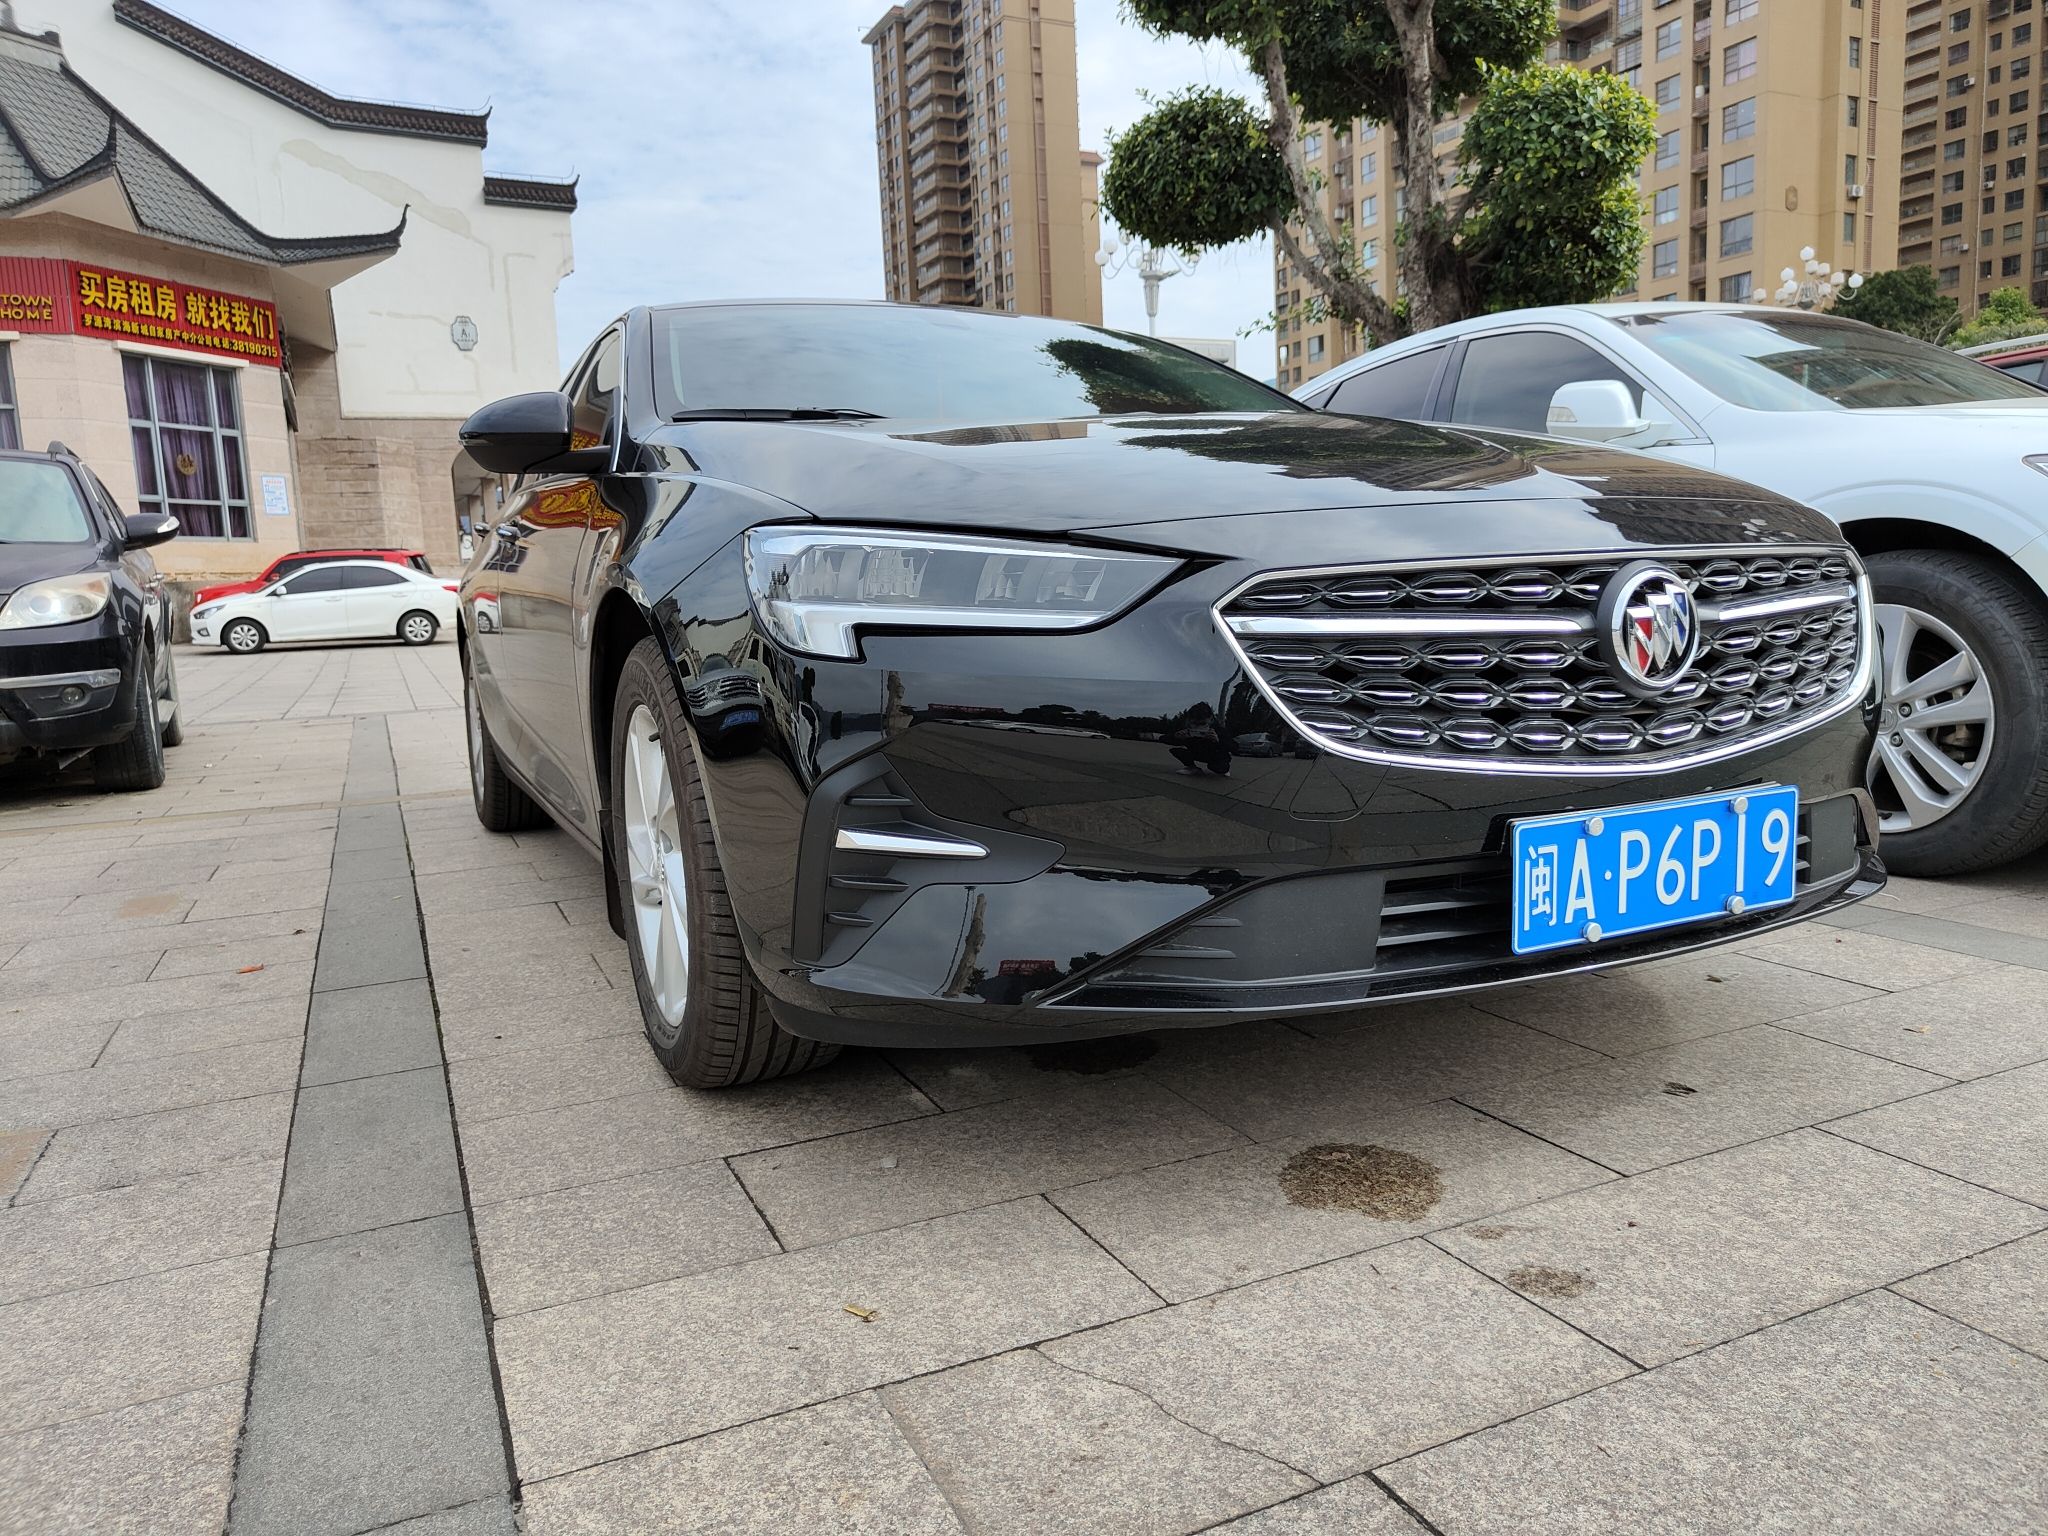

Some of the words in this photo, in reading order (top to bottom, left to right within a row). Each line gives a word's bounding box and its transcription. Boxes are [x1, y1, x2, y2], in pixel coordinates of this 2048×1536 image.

[0, 294, 52, 307] TOWN
[80, 270, 176, 322] 买房租房
[186, 292, 275, 340] 就找我们
[0, 308, 52, 320] HOME
